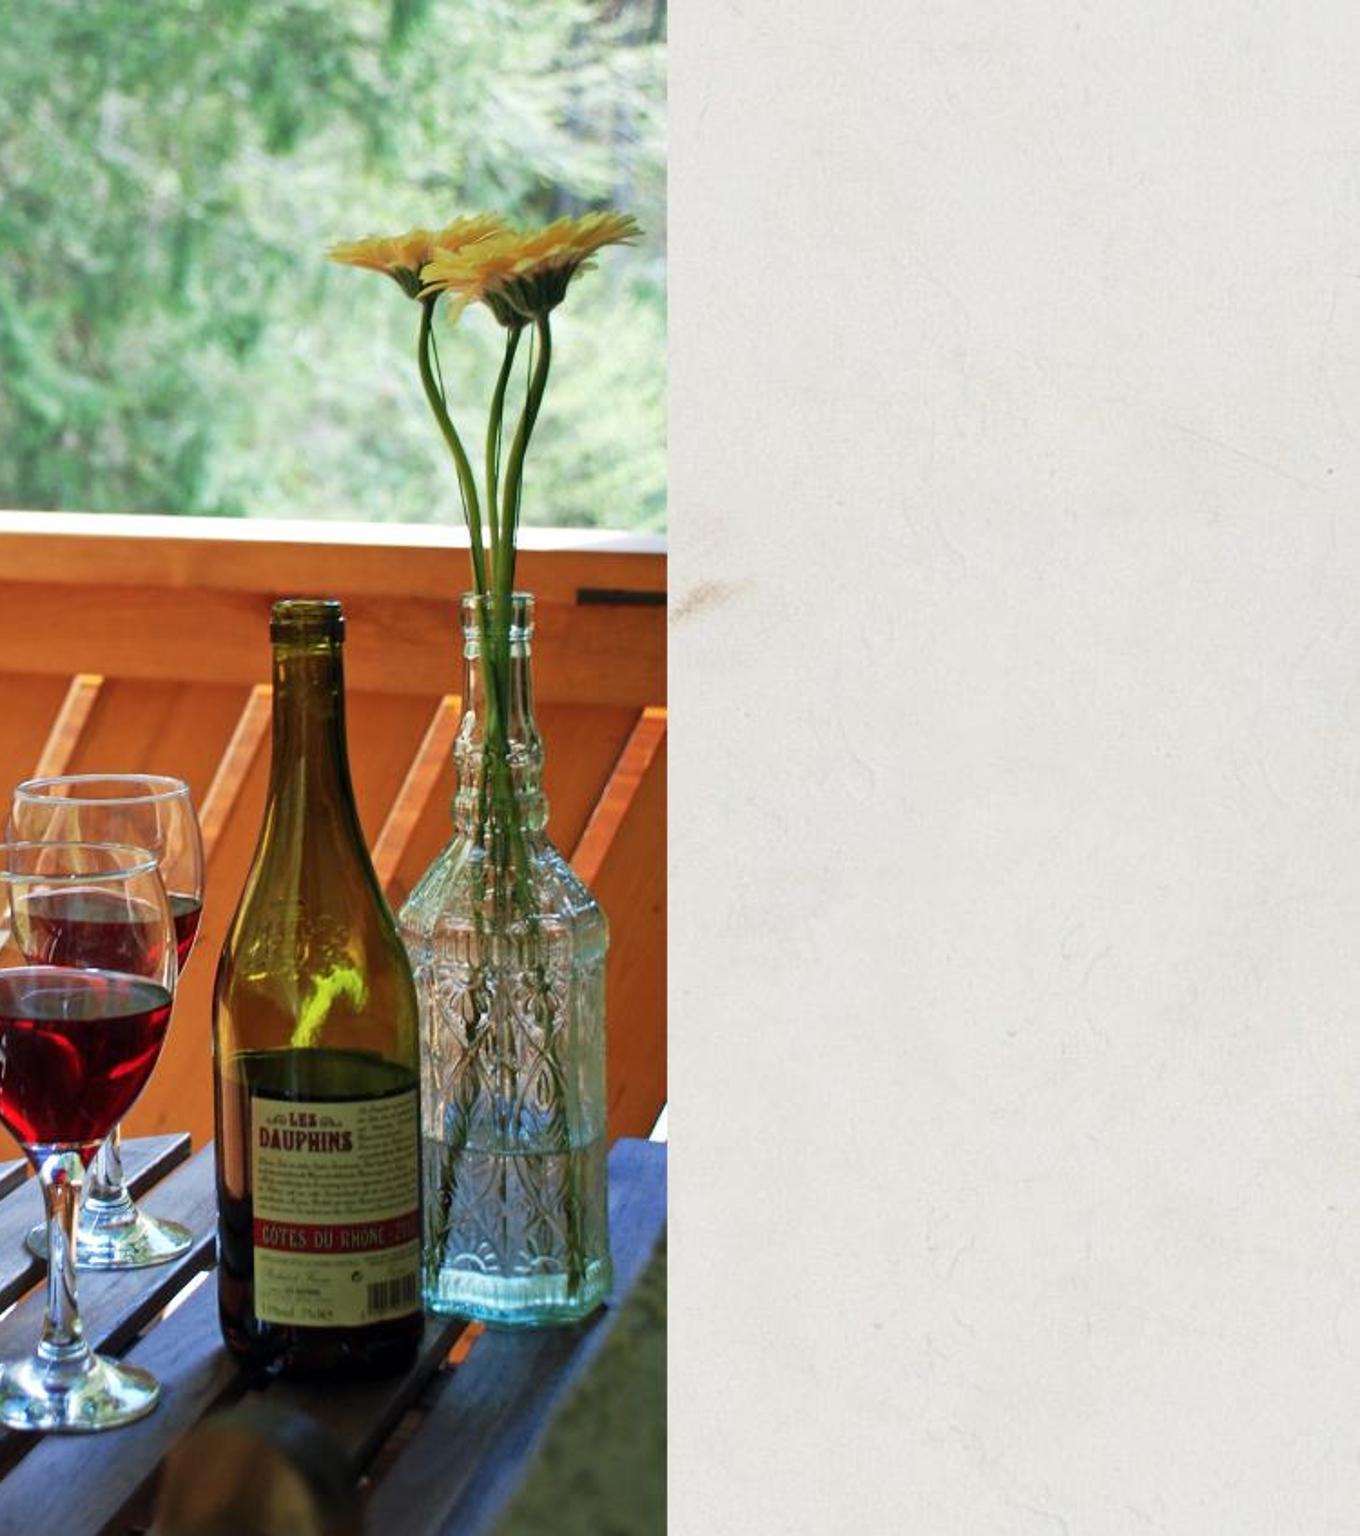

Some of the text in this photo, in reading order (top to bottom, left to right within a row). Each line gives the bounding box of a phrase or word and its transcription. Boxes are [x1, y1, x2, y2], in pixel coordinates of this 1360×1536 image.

[289, 1112, 318, 1127] LES
[259, 1127, 353, 1152] DAUPHINS
[314, 1230, 333, 1248] DU
